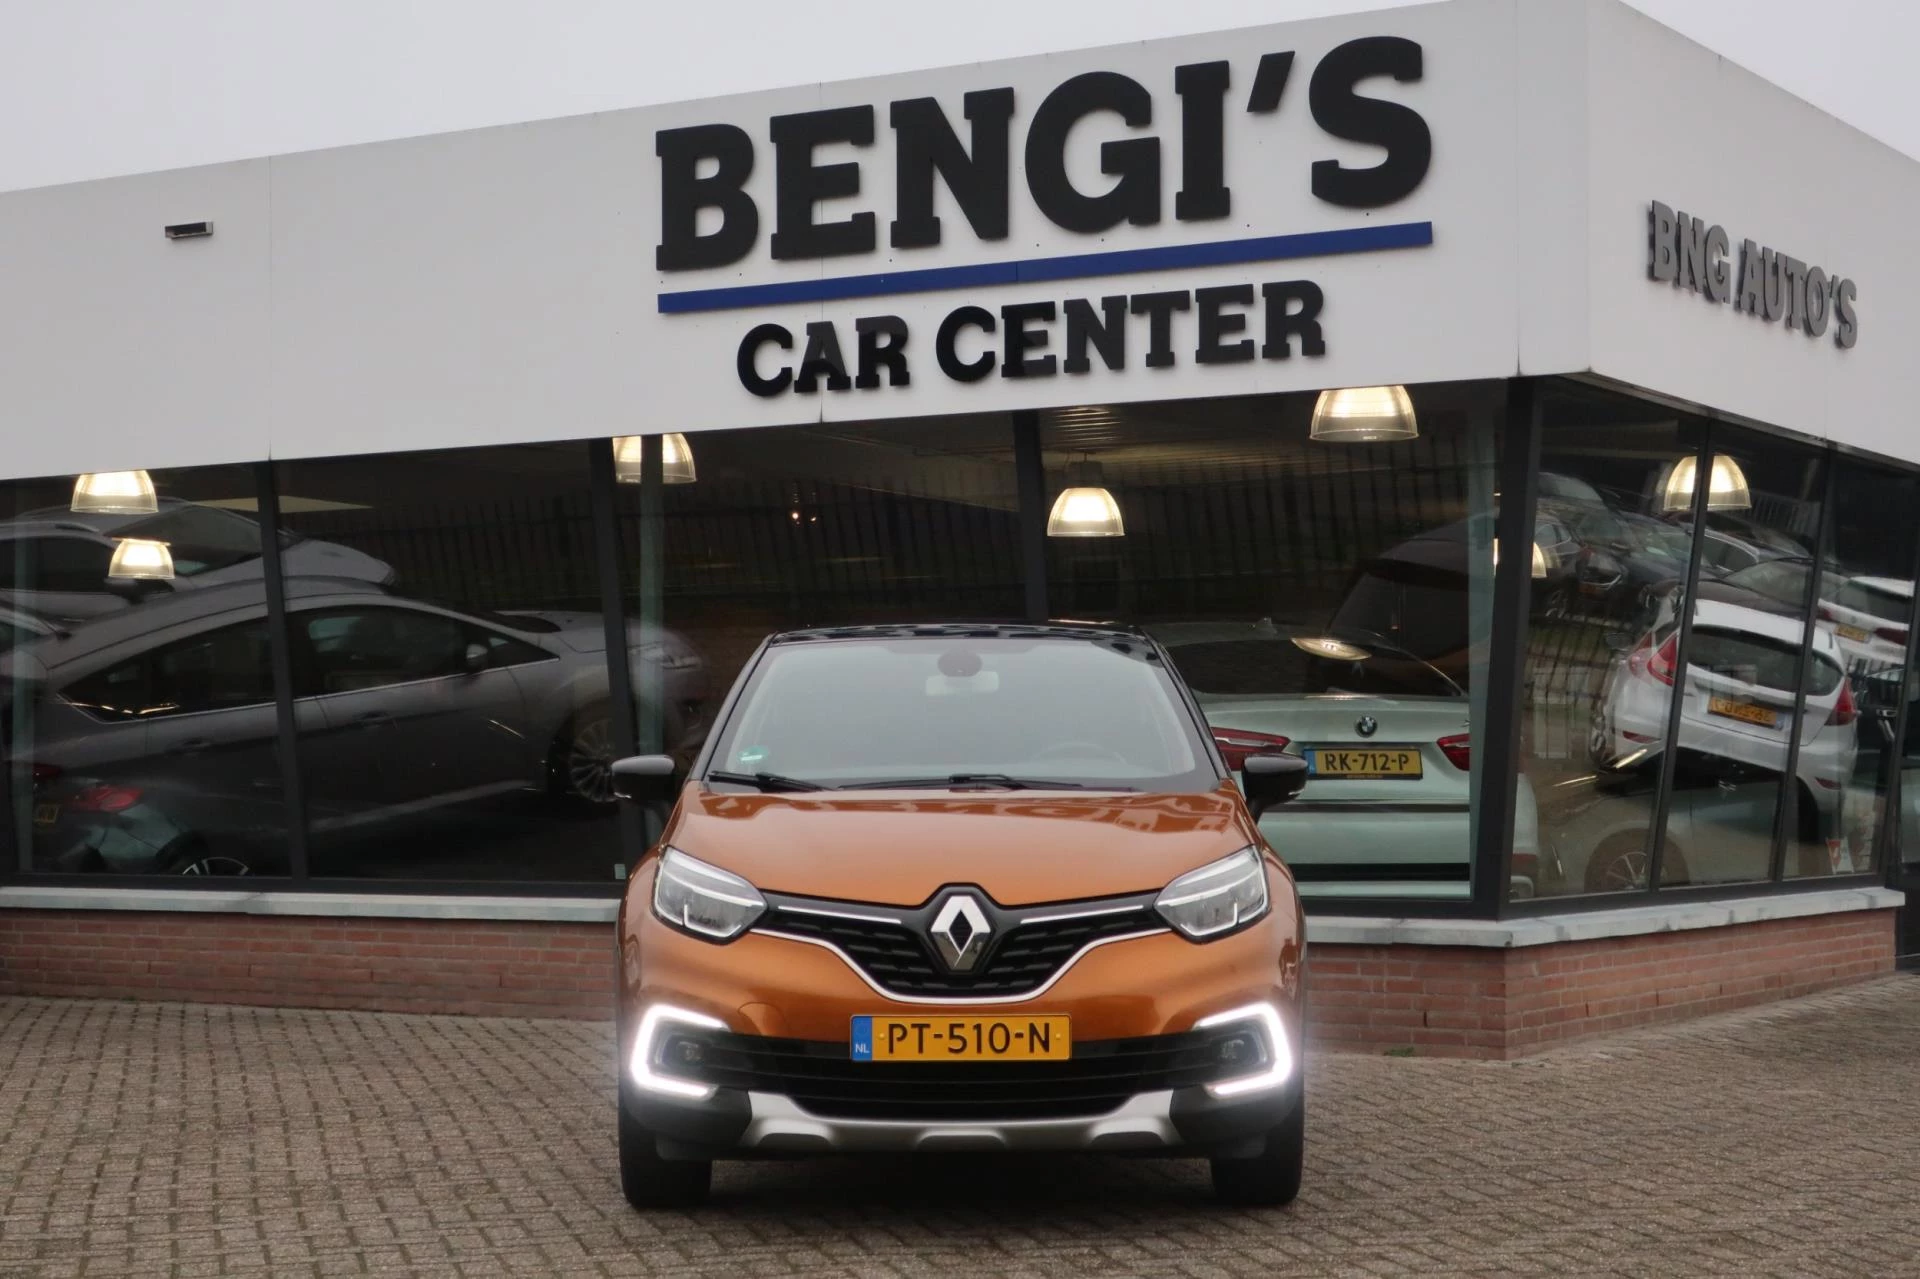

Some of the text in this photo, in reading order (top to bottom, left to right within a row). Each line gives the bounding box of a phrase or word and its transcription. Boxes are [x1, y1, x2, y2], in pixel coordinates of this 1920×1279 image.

[655, 35, 1433, 271] BENGI'S
[1649, 199, 1858, 349] BNG AUTO'S
[736, 279, 1326, 398] CAR CENTER
[1324, 753, 1410, 771] RK-712-P
[854, 1022, 1051, 1055] NL PT-510-N
